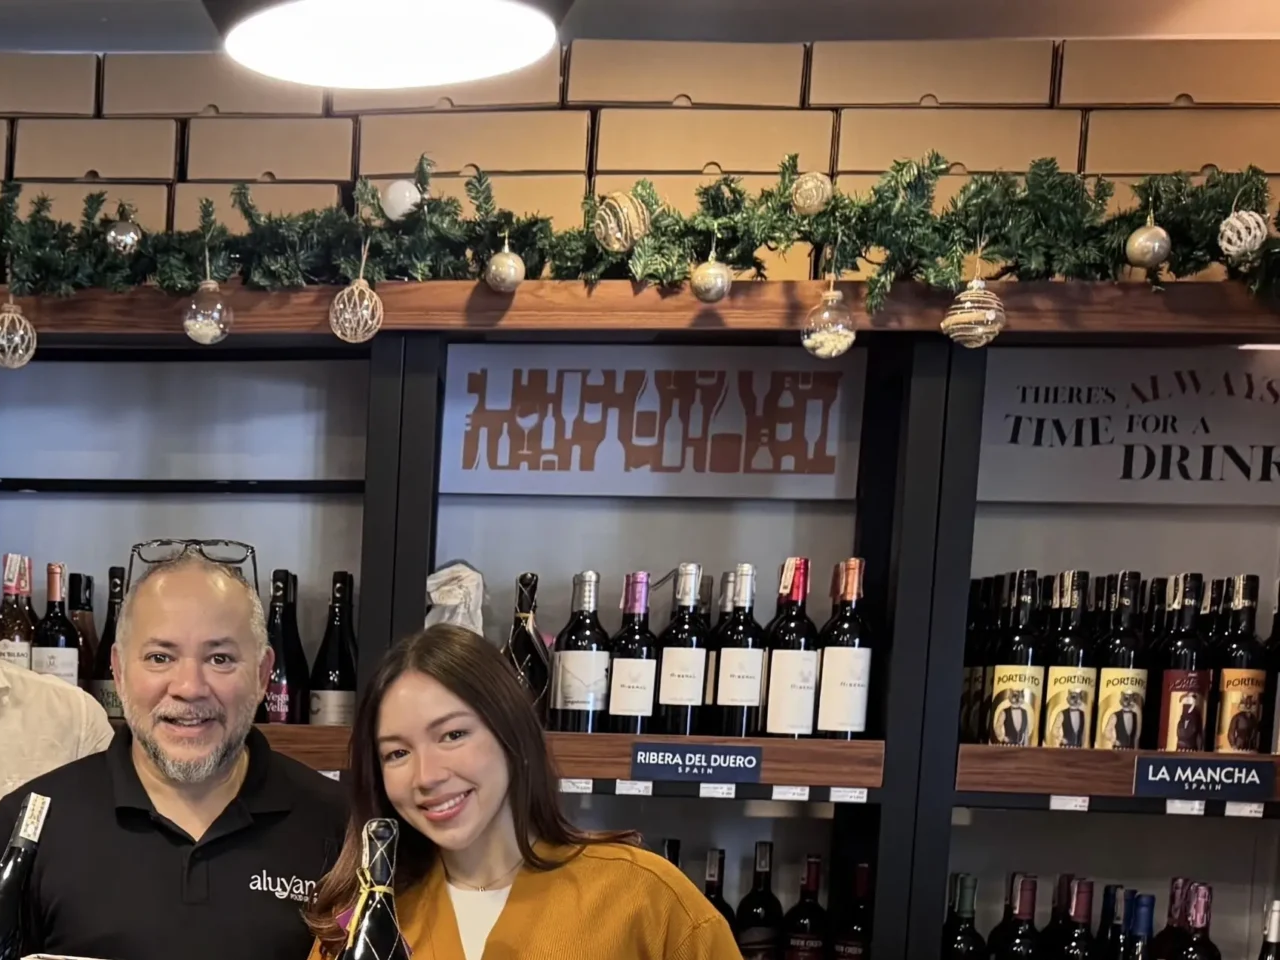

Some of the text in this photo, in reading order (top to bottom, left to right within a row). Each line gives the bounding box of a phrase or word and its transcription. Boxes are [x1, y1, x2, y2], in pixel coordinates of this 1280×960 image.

[1017, 385, 1116, 404] THERE'S
[1004, 414, 1210, 447] TIME FOR A
[637, 752, 756, 769] RIBERA DEL DUERO
[678, 766, 713, 775] SPAIN
[1148, 764, 1260, 784] LA MANCHA
[1184, 782, 1221, 791] SPAIN
